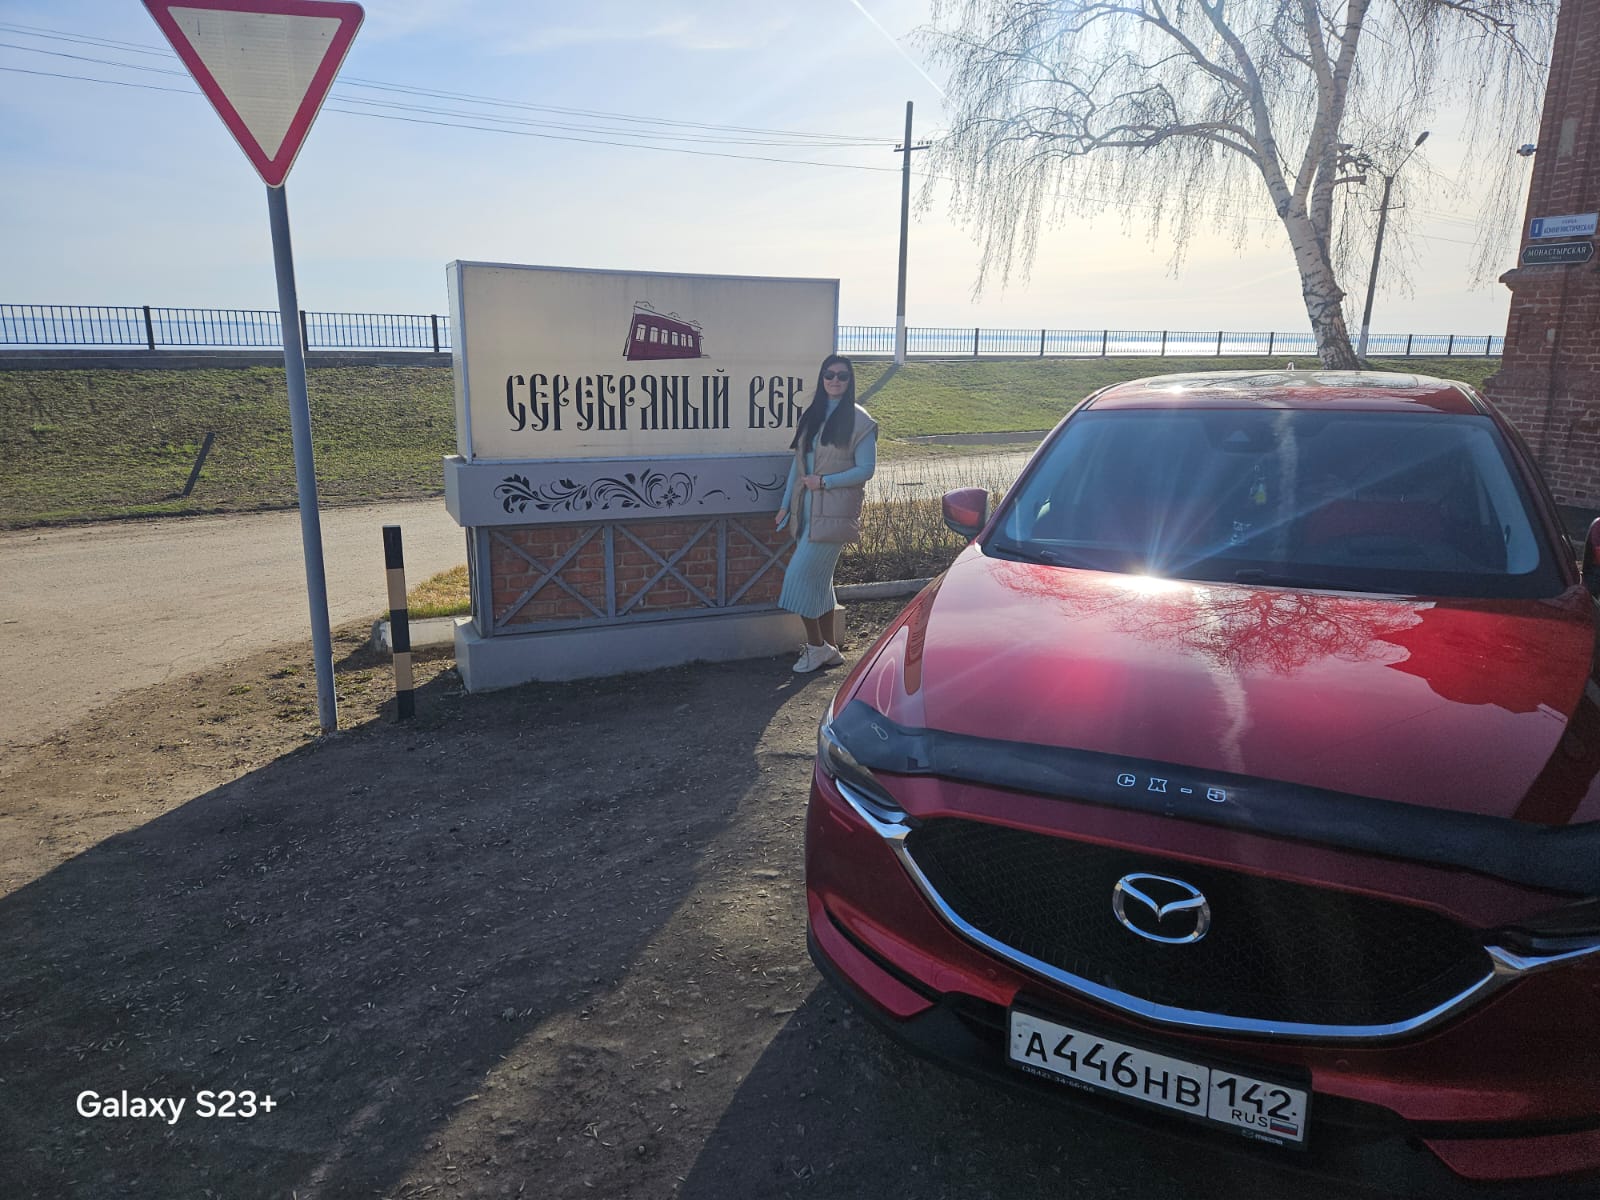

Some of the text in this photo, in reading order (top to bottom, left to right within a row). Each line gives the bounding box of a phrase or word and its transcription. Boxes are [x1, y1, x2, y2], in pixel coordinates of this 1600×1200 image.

[1527, 246, 1587, 257] МОНАСТЫРСКАЯ
[506, 368, 804, 432] СЕРЕБРЯНЫЙ ВЕК
[1025, 1031, 1292, 1121] А446НВ 142
[1231, 1109, 1268, 1128] RUS
